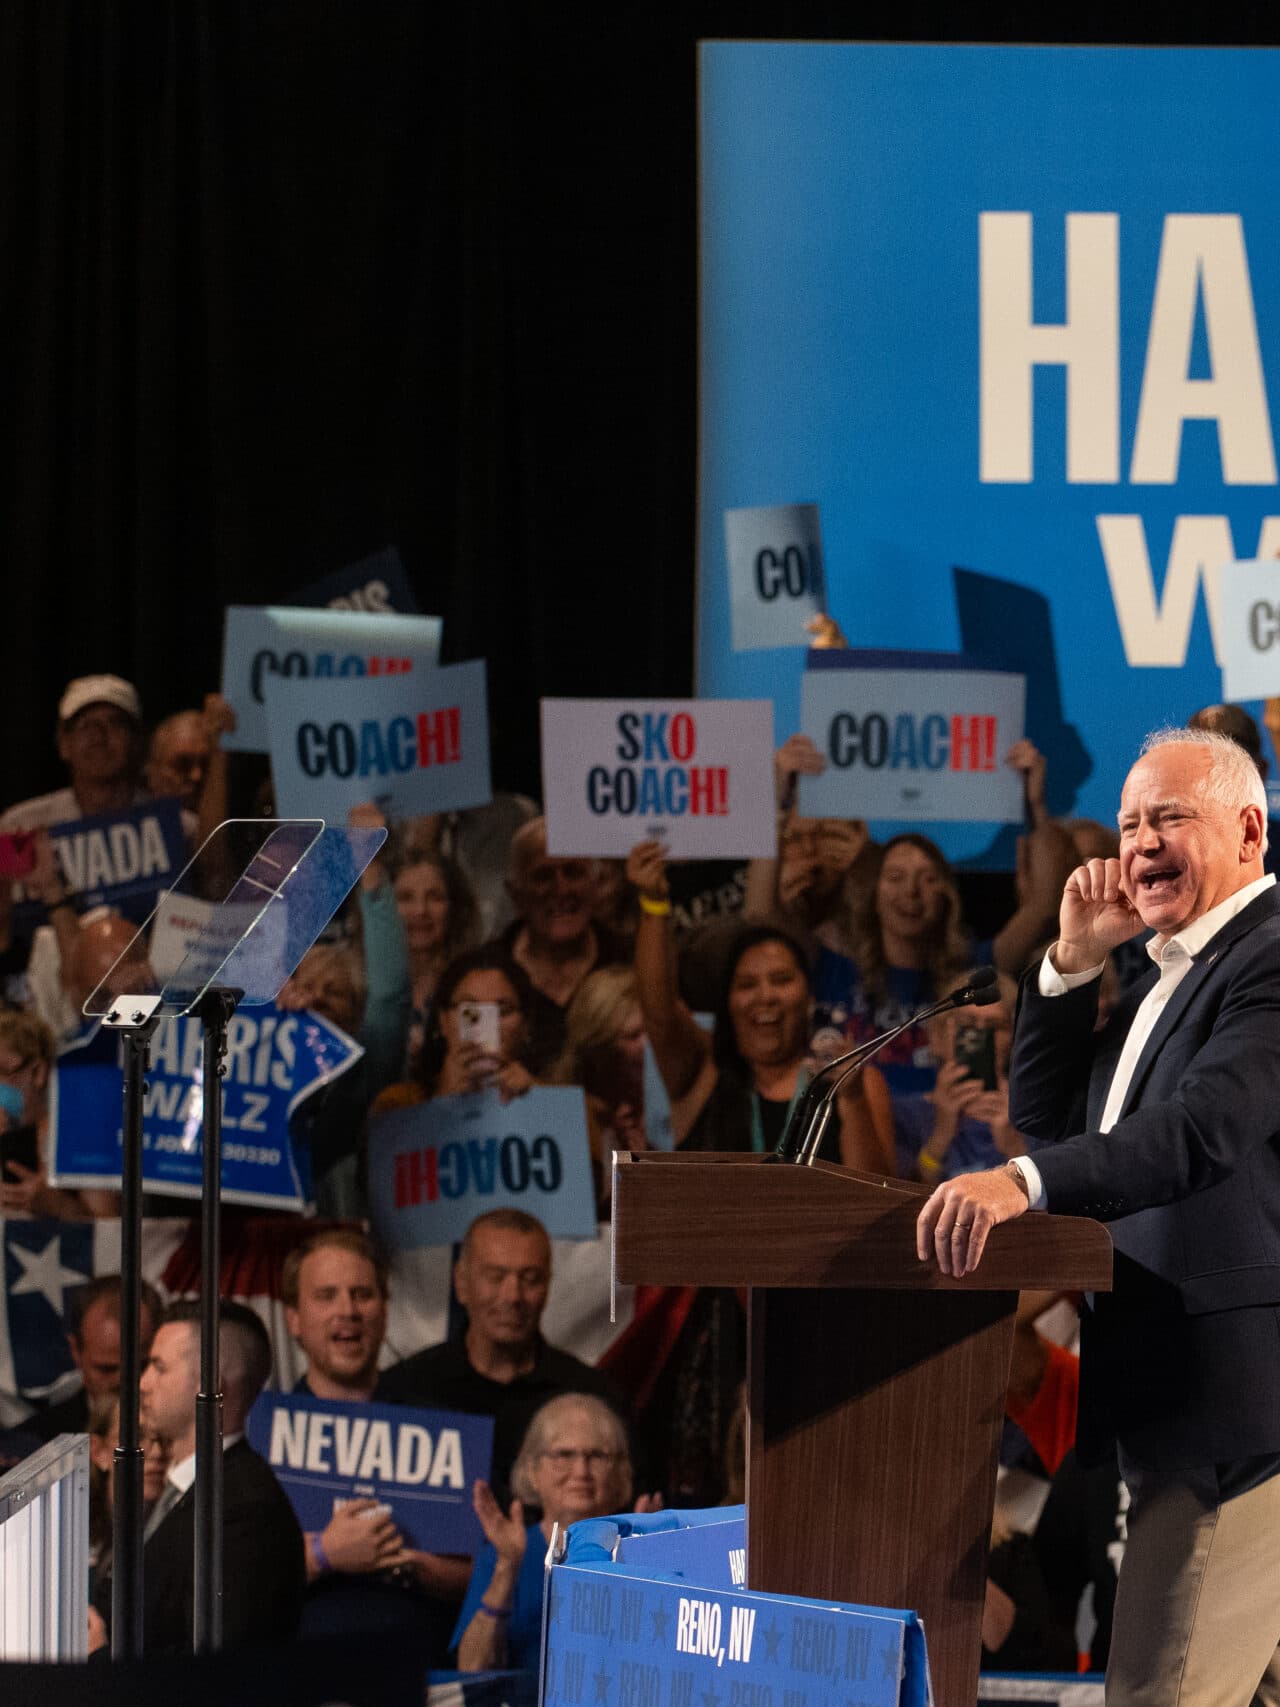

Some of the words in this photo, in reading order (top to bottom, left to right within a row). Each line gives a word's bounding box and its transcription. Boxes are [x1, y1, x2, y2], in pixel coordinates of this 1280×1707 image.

[297, 707, 459, 777] COACH!
[617, 711, 696, 762] SKO
[829, 712, 997, 772] COACH!
[586, 767, 729, 816] COACH!
[52, 815, 171, 894] VADA
[142, 1080, 269, 1132] WLZ
[393, 1135, 562, 1208] COACH!
[270, 1407, 464, 1489] NEVADA
[676, 1597, 726, 1667] RENO,
[728, 1606, 756, 1664] NV
